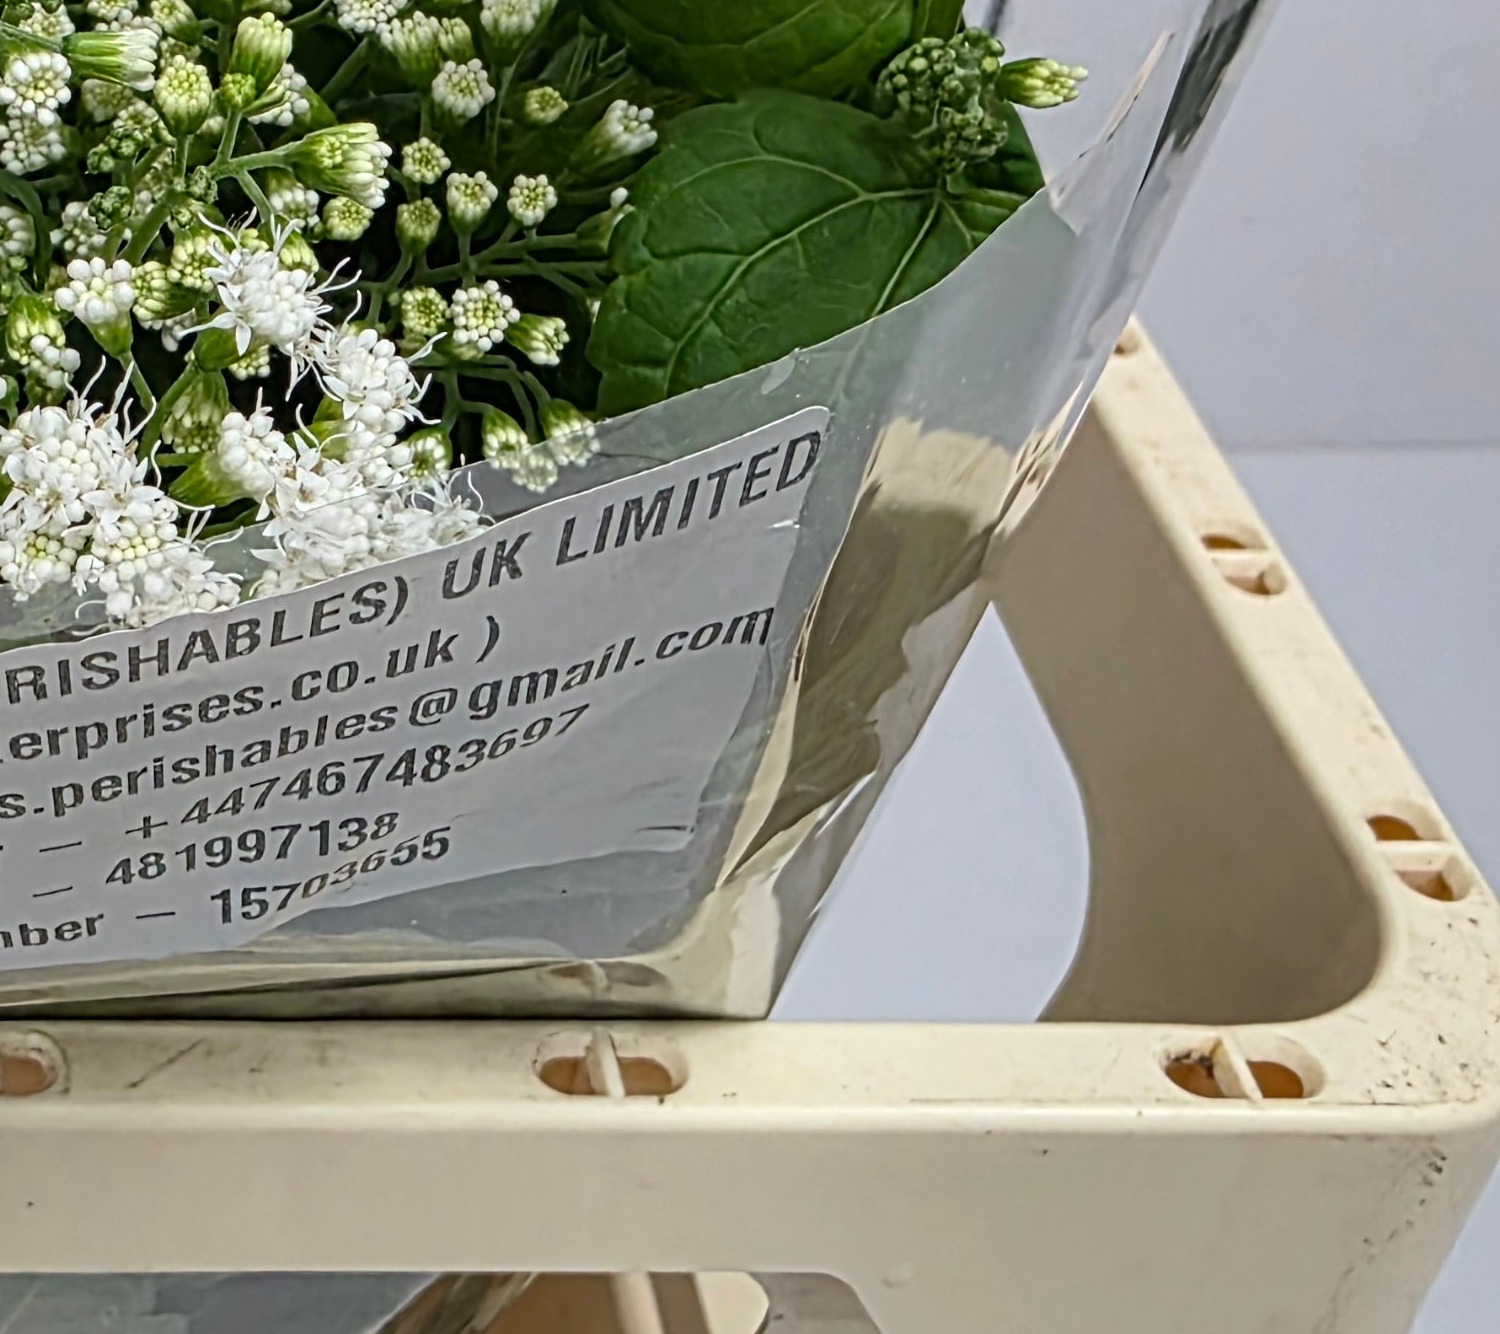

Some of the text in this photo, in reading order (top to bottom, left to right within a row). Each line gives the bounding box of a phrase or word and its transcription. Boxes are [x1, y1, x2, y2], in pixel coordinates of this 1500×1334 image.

[443, 539, 523, 600] UK
[556, 431, 822, 564] LIMITED
[125, 704, 590, 841] +447467483697
[105, 812, 400, 887] 481997138
[210, 826, 452, 926] 15703655
